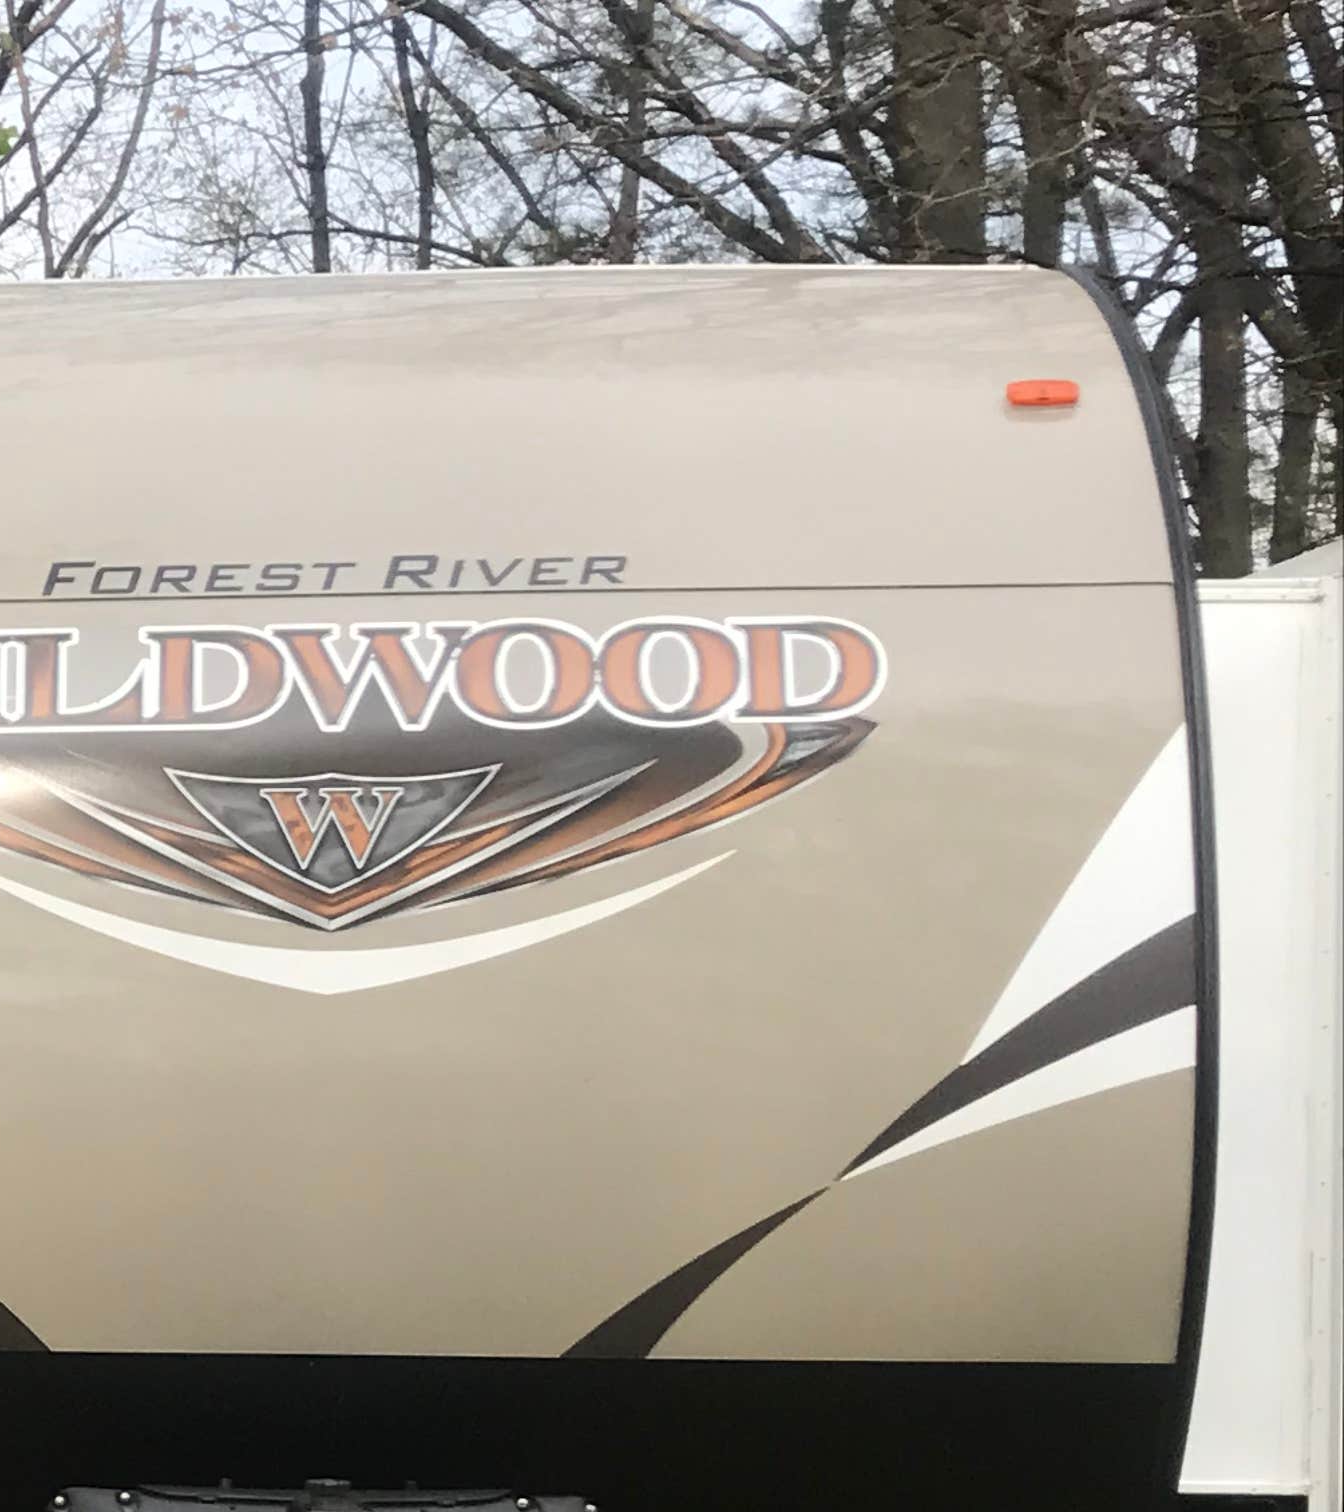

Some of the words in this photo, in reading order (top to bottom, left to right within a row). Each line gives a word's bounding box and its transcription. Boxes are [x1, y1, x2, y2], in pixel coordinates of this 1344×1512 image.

[42, 561, 357, 597] FOREST
[382, 554, 628, 589] RIVER
[259, 786, 405, 870] W
